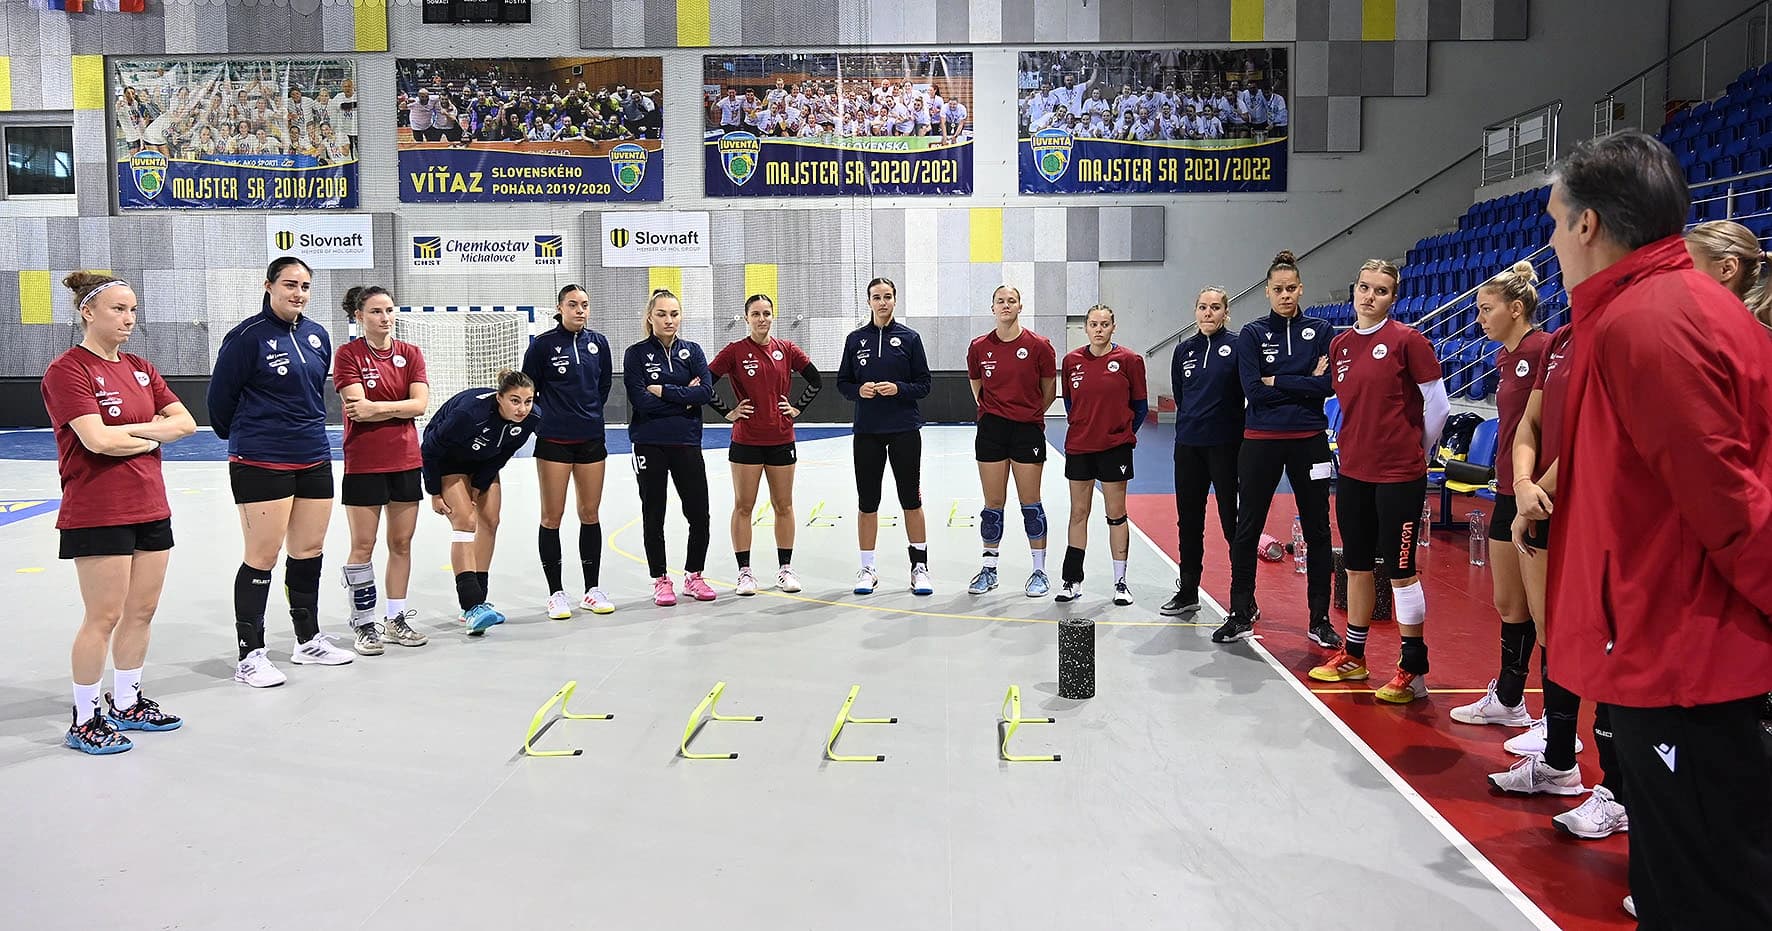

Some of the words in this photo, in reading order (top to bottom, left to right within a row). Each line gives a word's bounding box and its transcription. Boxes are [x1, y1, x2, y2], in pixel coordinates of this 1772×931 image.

[491, 164, 583, 178] SLOVENSKÉHO
[765, 160, 839, 186] MAJSTER
[845, 160, 865, 186] SR
[871, 160, 958, 184] 2020/2021
[1078, 158, 1152, 183] MAJSTER
[1158, 158, 1178, 183] SR
[1184, 158, 1271, 182] 2021/2022
[410, 166, 484, 193] VÍŤAZ
[172, 177, 238, 200] MAJSTER
[247, 177, 266, 200] SR
[274, 176, 348, 198] 2018/2019
[492, 181, 544, 195] POHÁRA
[546, 183, 611, 195] 2019/2020
[300, 233, 363, 247] Slovnaft
[635, 230, 699, 245] Slovnaft
[446, 239, 530, 252] Chemkostav
[460, 253, 516, 263] Michalovce
[1398, 521, 1414, 569] macron
